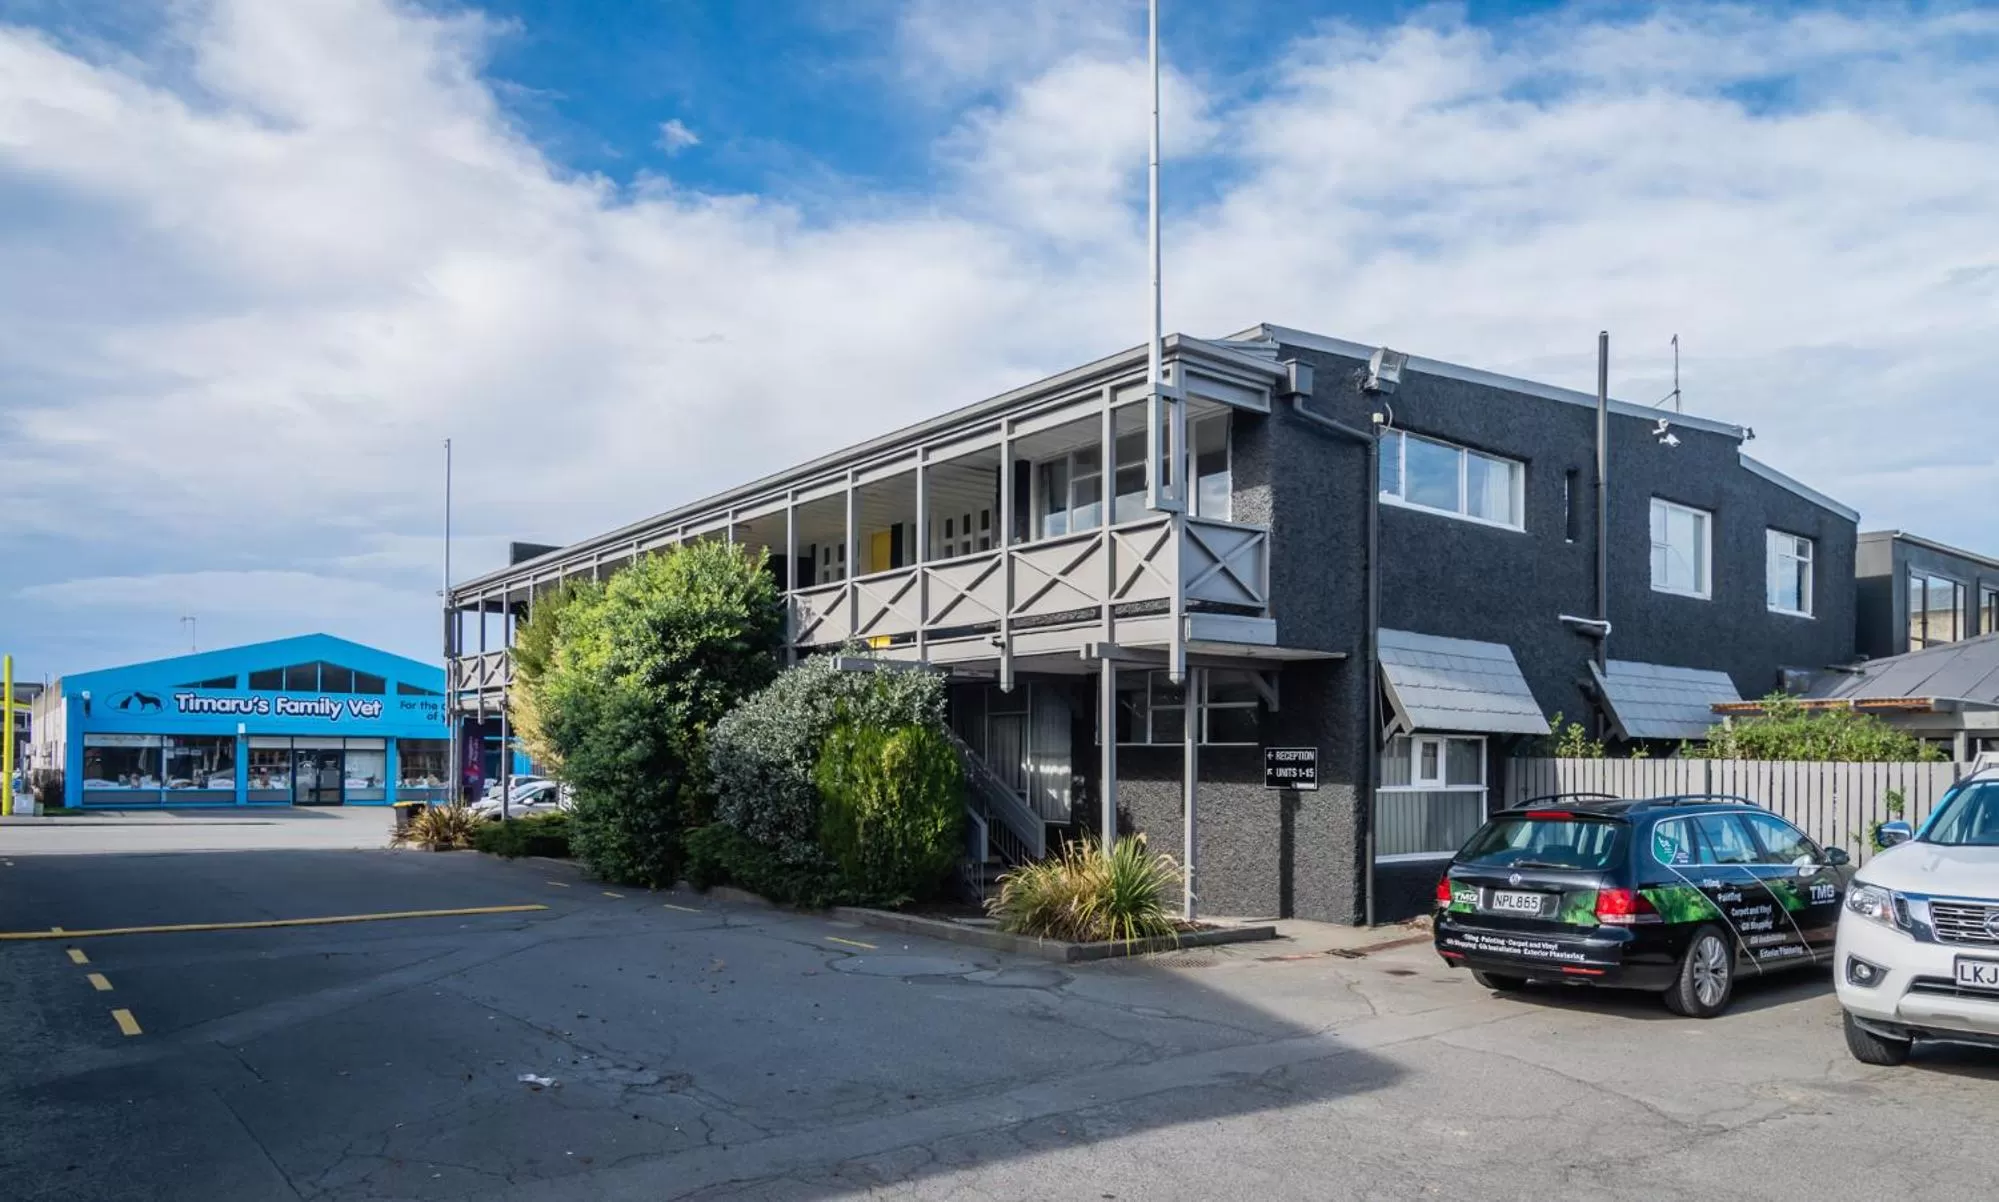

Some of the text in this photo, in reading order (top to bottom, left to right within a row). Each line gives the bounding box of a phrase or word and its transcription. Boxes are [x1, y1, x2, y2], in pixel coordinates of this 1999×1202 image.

[175, 692, 383, 720] Timaru's Family Vet
[400, 701, 416, 710] For
[420, 701, 438, 711] the
[426, 711, 438, 721] of
[1275, 751, 1315, 761] RECEPTION
[1276, 767, 1315, 778] UNITS 1-15
[1453, 891, 1478, 902] TMG
[1809, 884, 1835, 900] TMG
[1494, 895, 1539, 909] NPL865
[1508, 939, 1528, 948] Carpet
[1542, 942, 1558, 950] Vinyl
[1524, 947, 1549, 957] Exterior
[1960, 964, 1998, 984] LKJ
